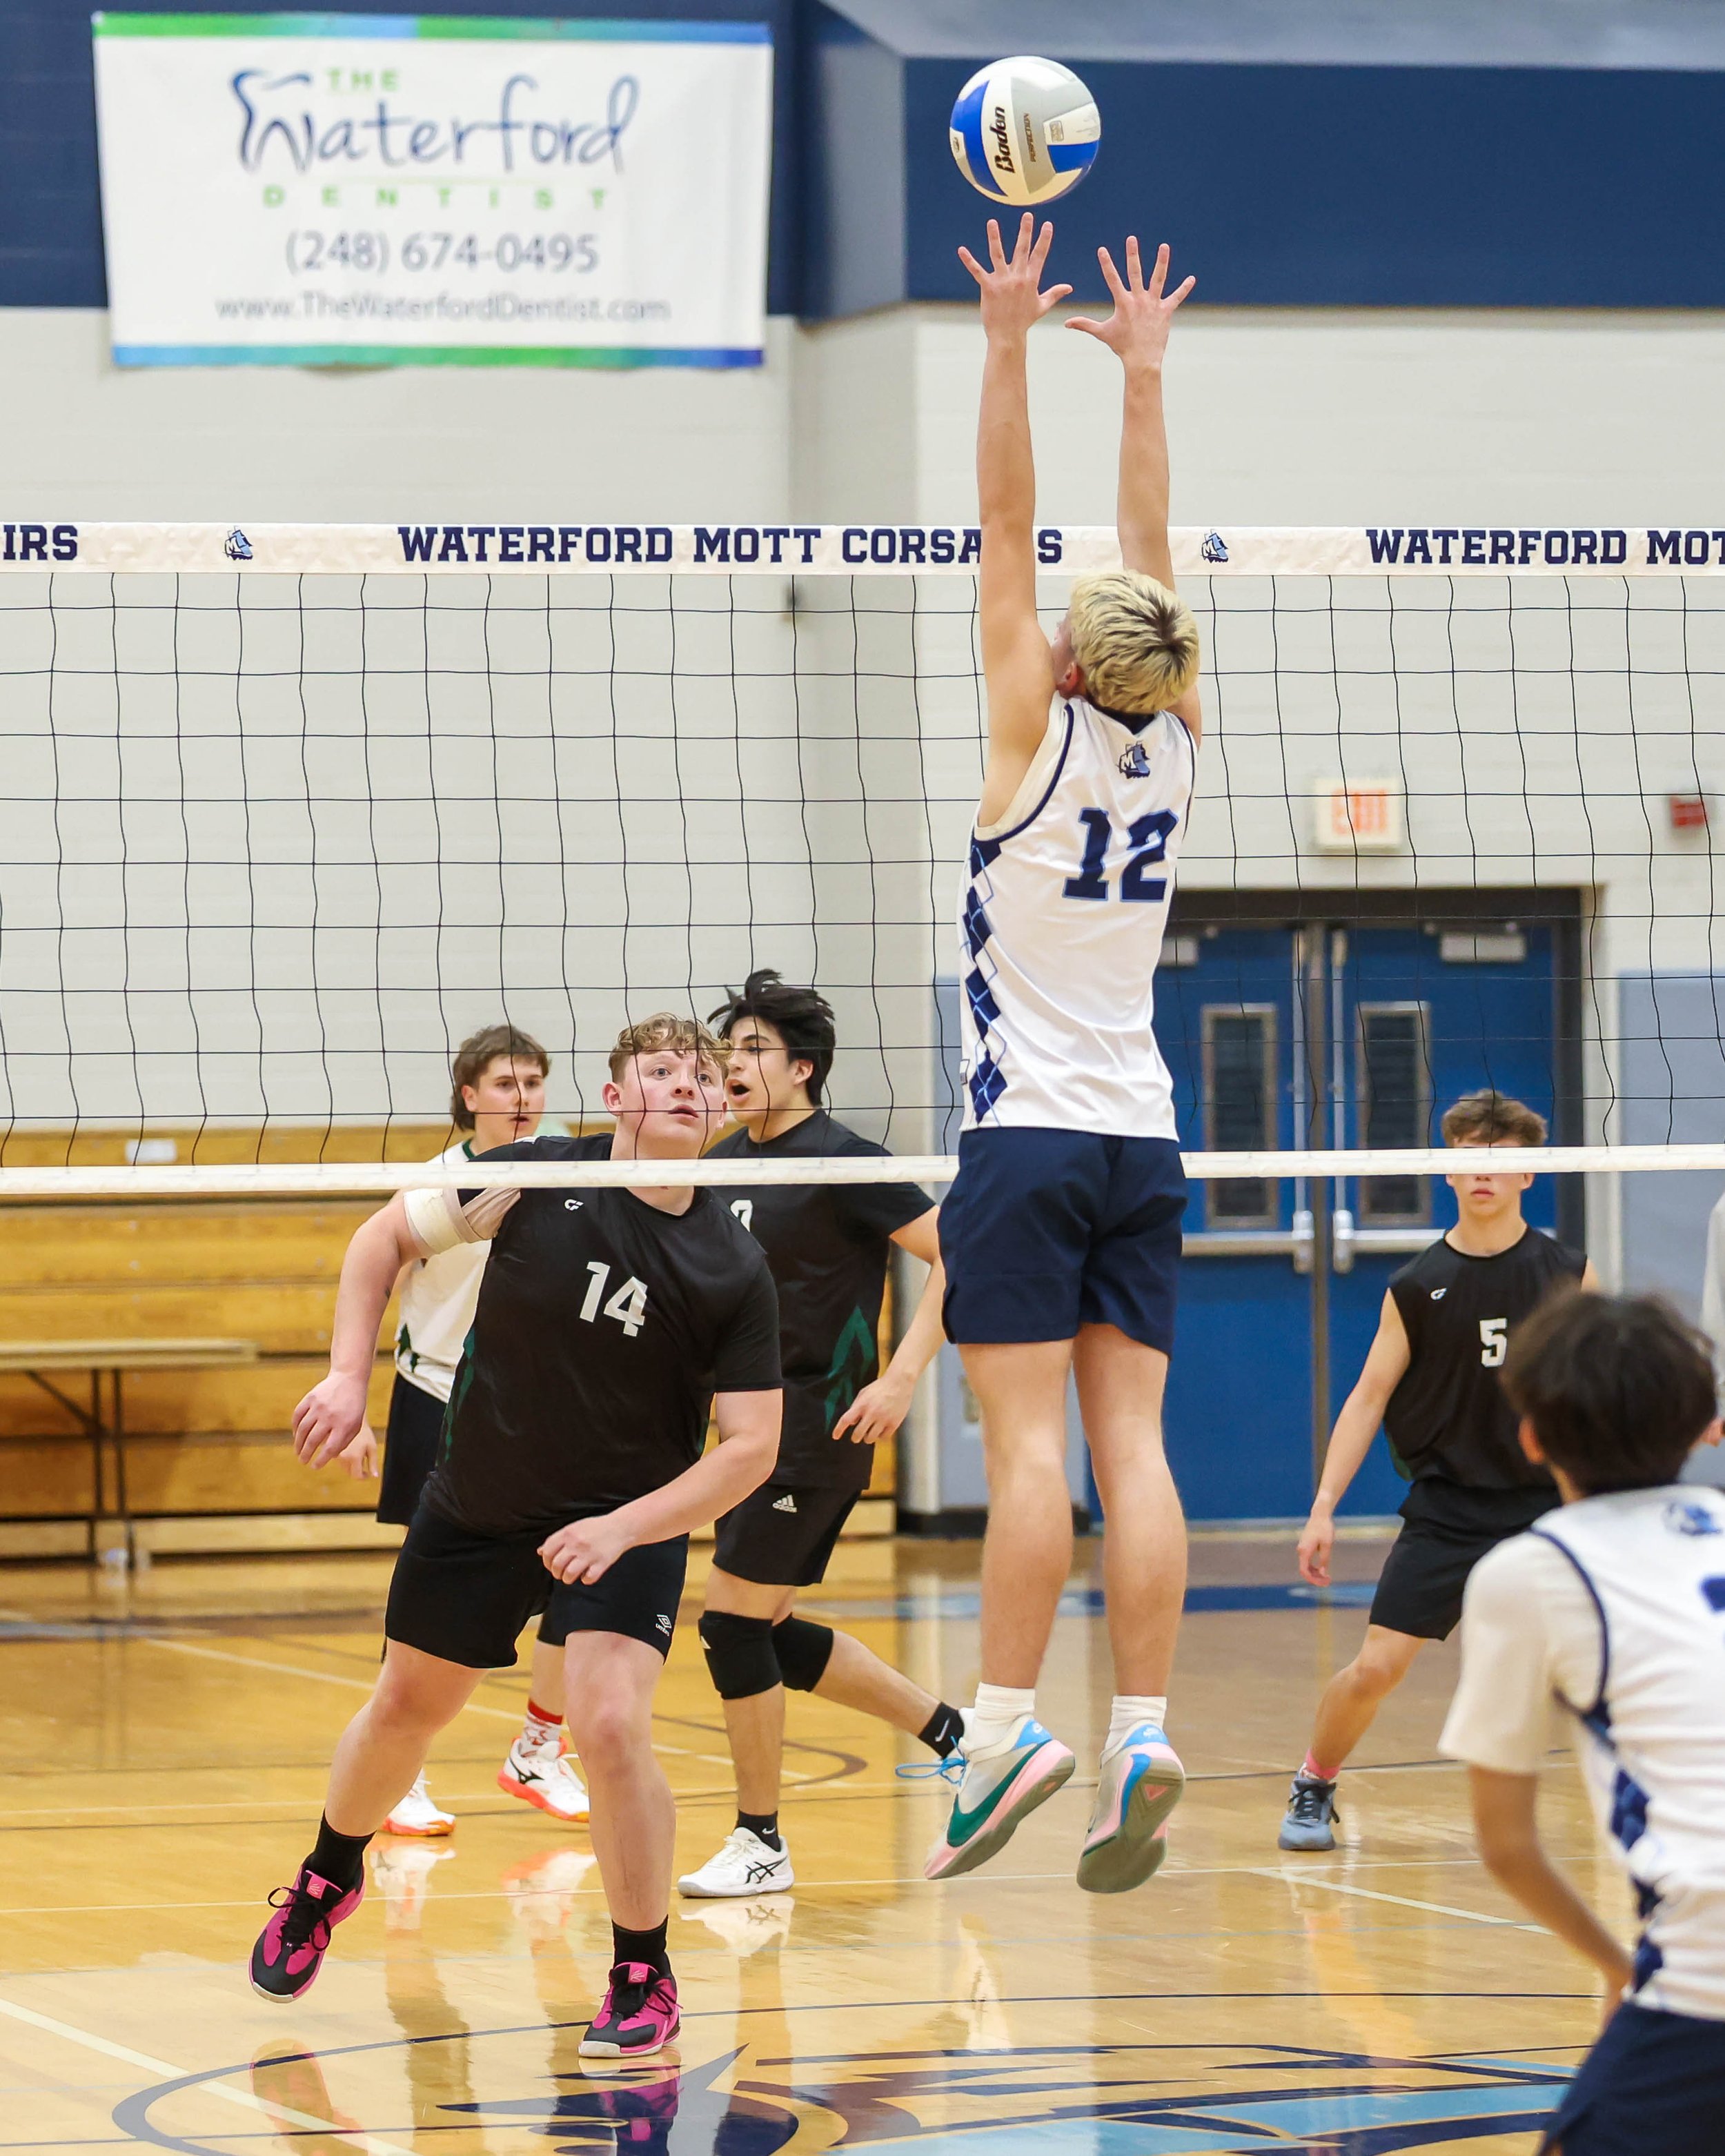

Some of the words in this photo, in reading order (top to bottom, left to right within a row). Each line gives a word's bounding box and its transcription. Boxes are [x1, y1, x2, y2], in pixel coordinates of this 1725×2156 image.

[326, 67, 400, 92] THE
[231, 67, 641, 174] Waterford
[989, 106, 1015, 173] Baden
[263, 185, 607, 208] DENTIST
[286, 230, 389, 276] (248)
[402, 232, 599, 273] 674-0495
[398, 526, 672, 562] WATERFORD
[693, 528, 822, 562] MOTT
[842, 528, 1062, 564] CORSAS
[1366, 529, 1626, 564] WATERFORD
[1062, 807, 1179, 902] 12
[579, 1261, 648, 1336] 14
[1479, 1318, 1507, 1367] 5
